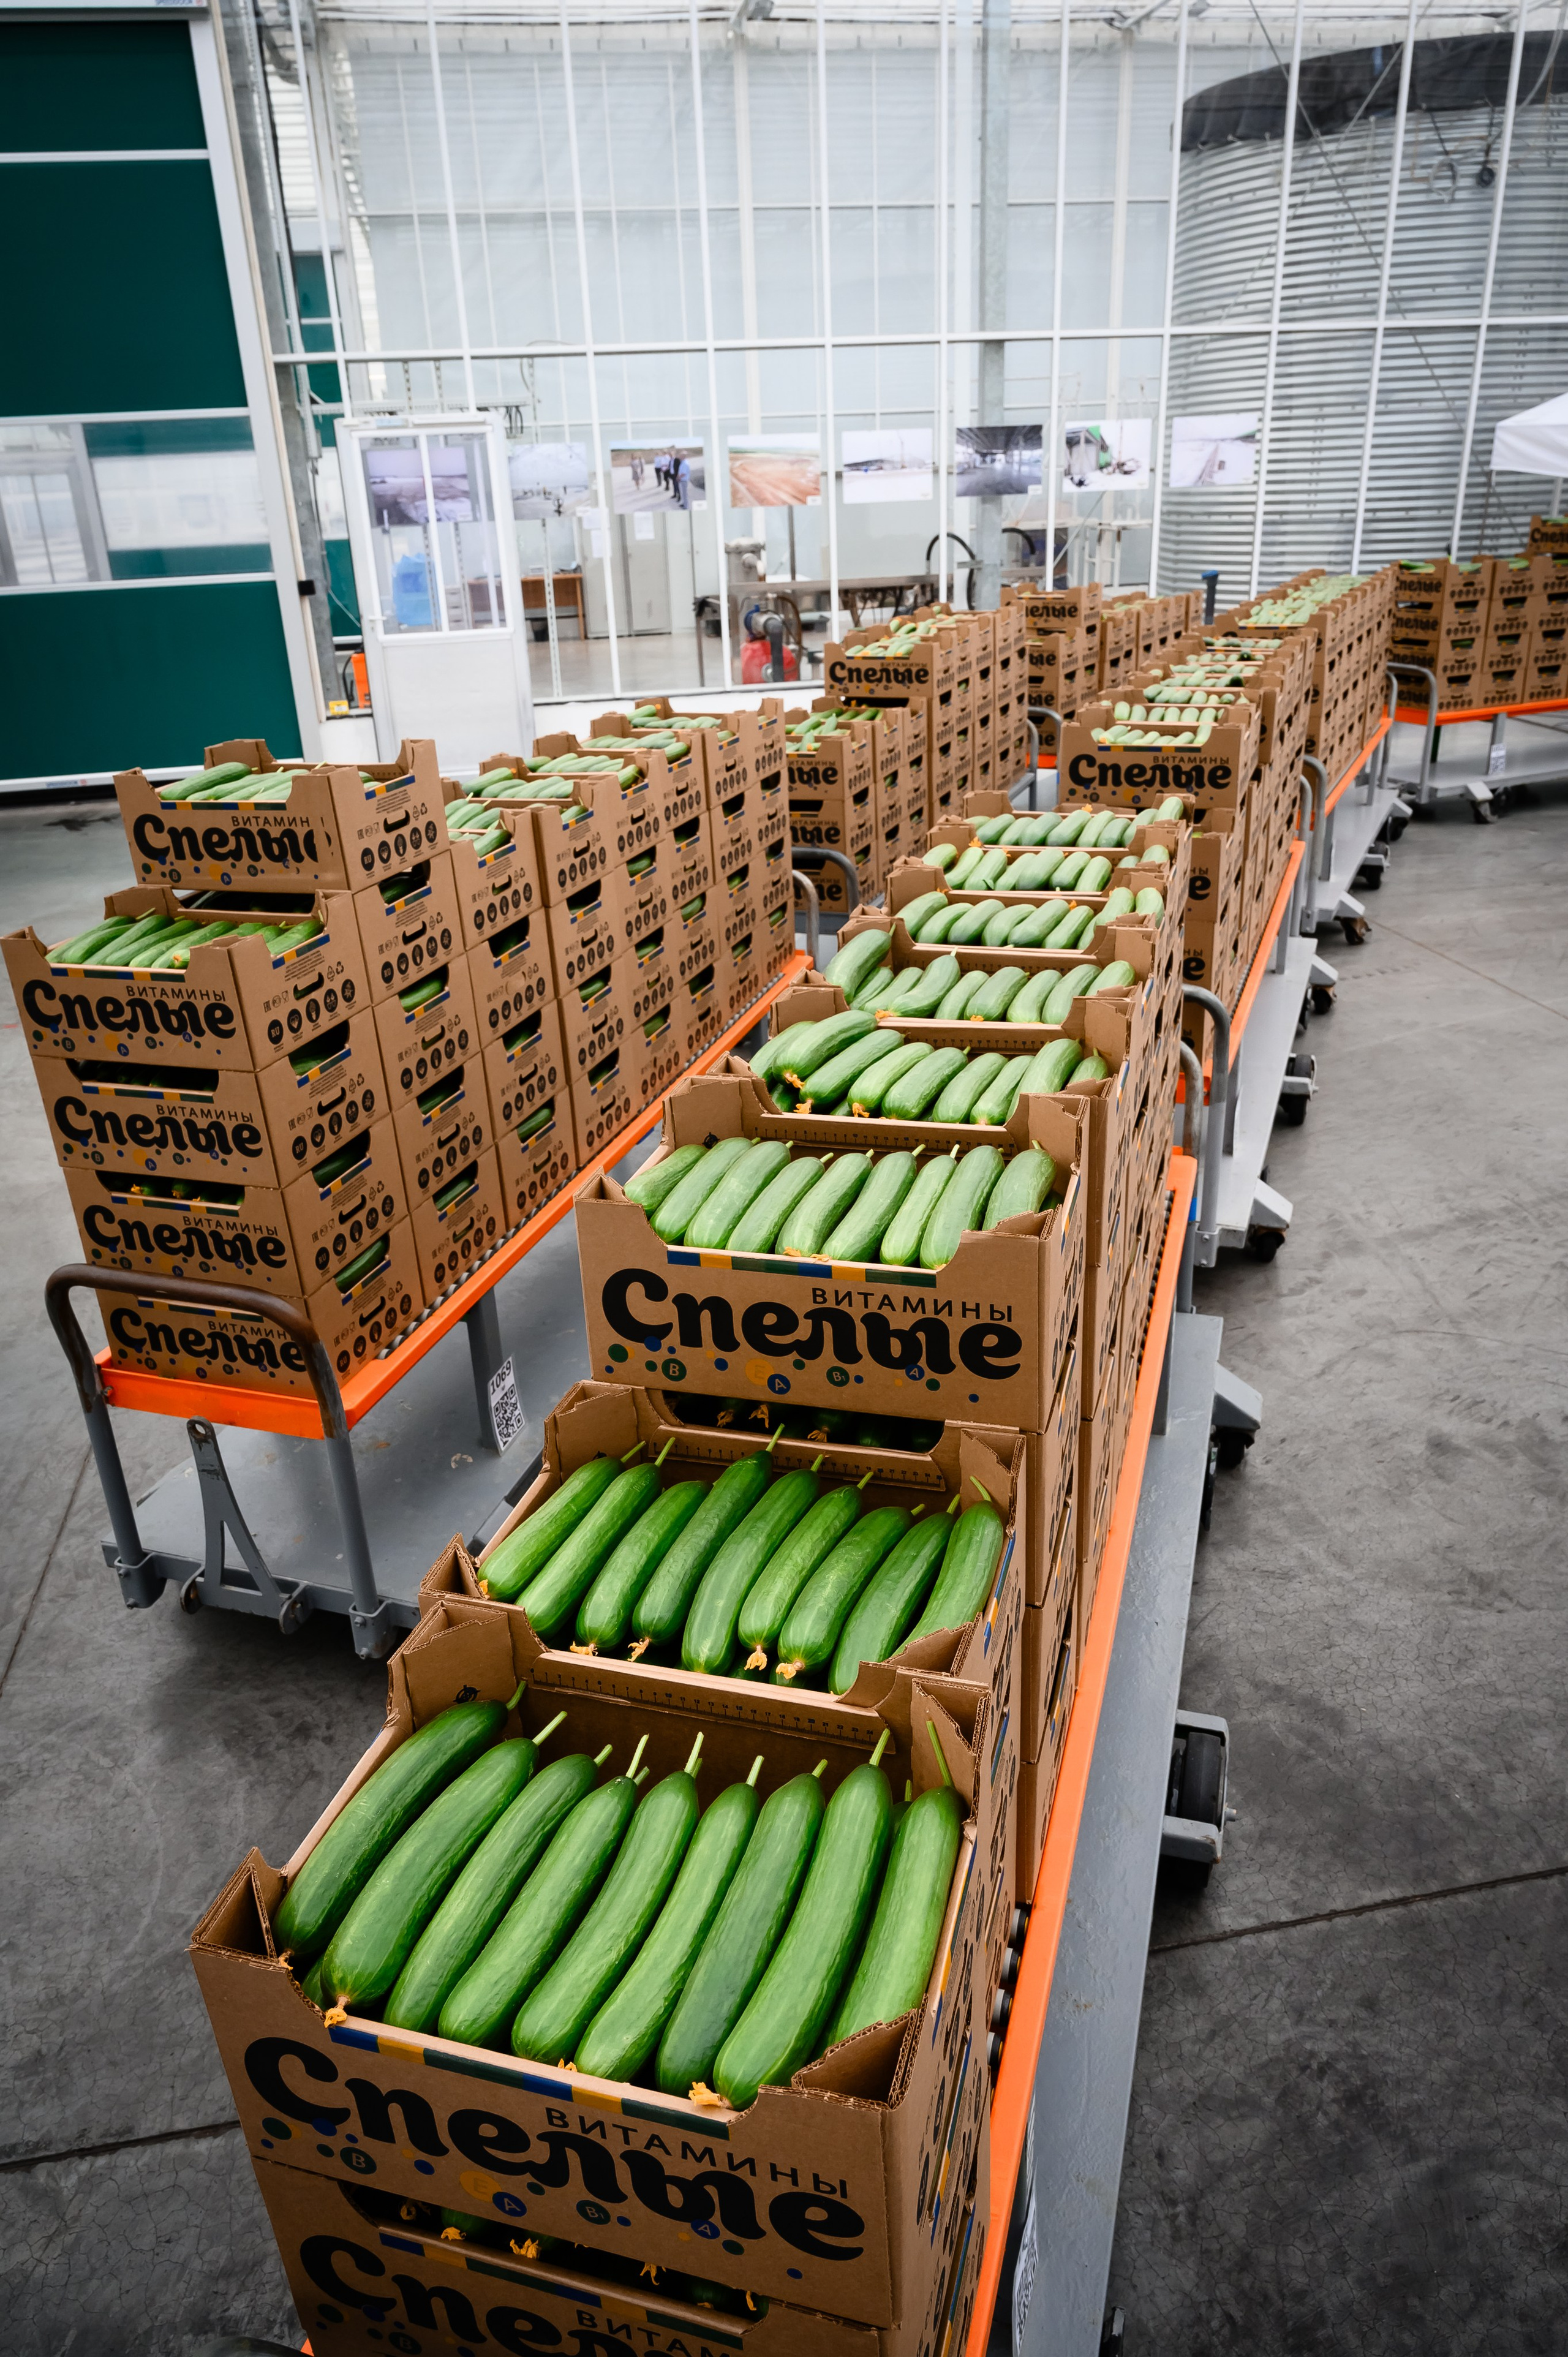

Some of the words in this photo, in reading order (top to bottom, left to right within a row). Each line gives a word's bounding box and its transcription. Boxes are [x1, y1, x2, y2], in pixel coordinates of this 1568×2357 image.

[1026, 606, 1077, 617] елые
[829, 661, 929, 684] Спелые
[1153, 756, 1229, 764] ВИТАМИНЫ
[1069, 753, 1232, 790] Спелые
[126, 986, 226, 1001] ВИТАМИНЫ
[23, 979, 236, 1039] Спелые
[271, 1026, 280, 1038] RU
[156, 1104, 254, 1123] ВИТАМИНЫ
[54, 1096, 263, 1158] Спелые
[295, 1142, 304, 1154] RU
[183, 1215, 278, 1236] ВИТАМИНЫ
[83, 1205, 287, 1269] Спелые
[811, 1287, 1013, 1322] ВИТАМИНЫ
[208, 1321, 292, 1340] ВИТАМИН
[602, 1268, 1023, 1380] Спелые
[110, 1308, 307, 1373] Спелые
[491, 1360, 511, 1395] 1069
[669, 1363, 679, 1376] B
[910, 1367, 920, 1378] A
[774, 1379, 787, 1392] A
[245, 2036, 865, 2261] Спелые
[545, 2106, 849, 2200] ВИТАМИНЫ
[351, 2152, 367, 2170] B
[472, 2178, 489, 2195] E
[503, 2196, 522, 2214] A
[696, 2222, 713, 2236] A
[300, 2234, 676, 2357] Спе
[576, 2309, 723, 2357] ВИТА
[401, 2337, 412, 2350] B
